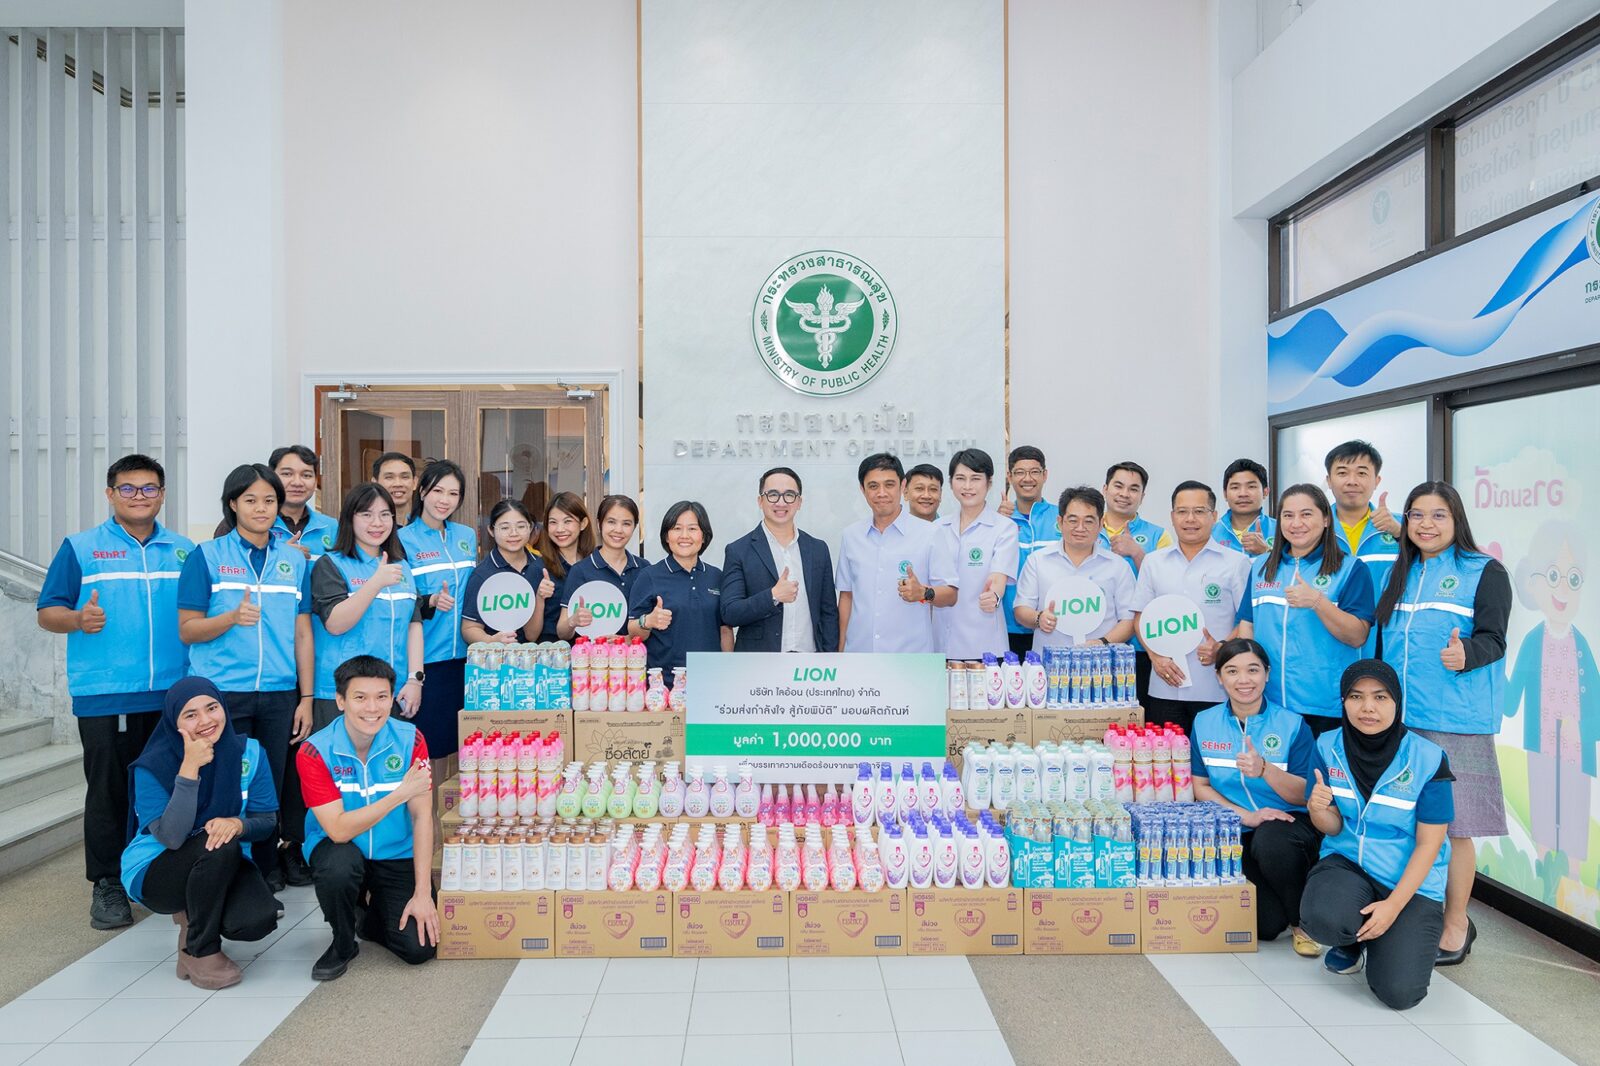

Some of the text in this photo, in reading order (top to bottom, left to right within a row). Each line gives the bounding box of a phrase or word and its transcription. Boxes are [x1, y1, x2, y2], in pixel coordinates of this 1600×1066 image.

[762, 255, 887, 304] กระทรวงสาธารณสุข
[762, 334, 889, 389] MINISTRY OF PUBLIC HEALTH
[736, 400, 914, 433] กรมอนามัย
[673, 438, 978, 458] DEPARTMENT OF HEALTH
[481, 592, 530, 612] LION
[1145, 612, 1198, 640] LION
[793, 667, 837, 682] LION
[749, 686, 881, 698] บริษัท ไลอ้อน (ประเทศไทย) จำกัด
[841, 704, 910, 717] มอบผลิตภัณฑ์
[733, 731, 892, 750] มูลค่า 1,000,000 บาท
[1201, 741, 1232, 751] SEhRT
